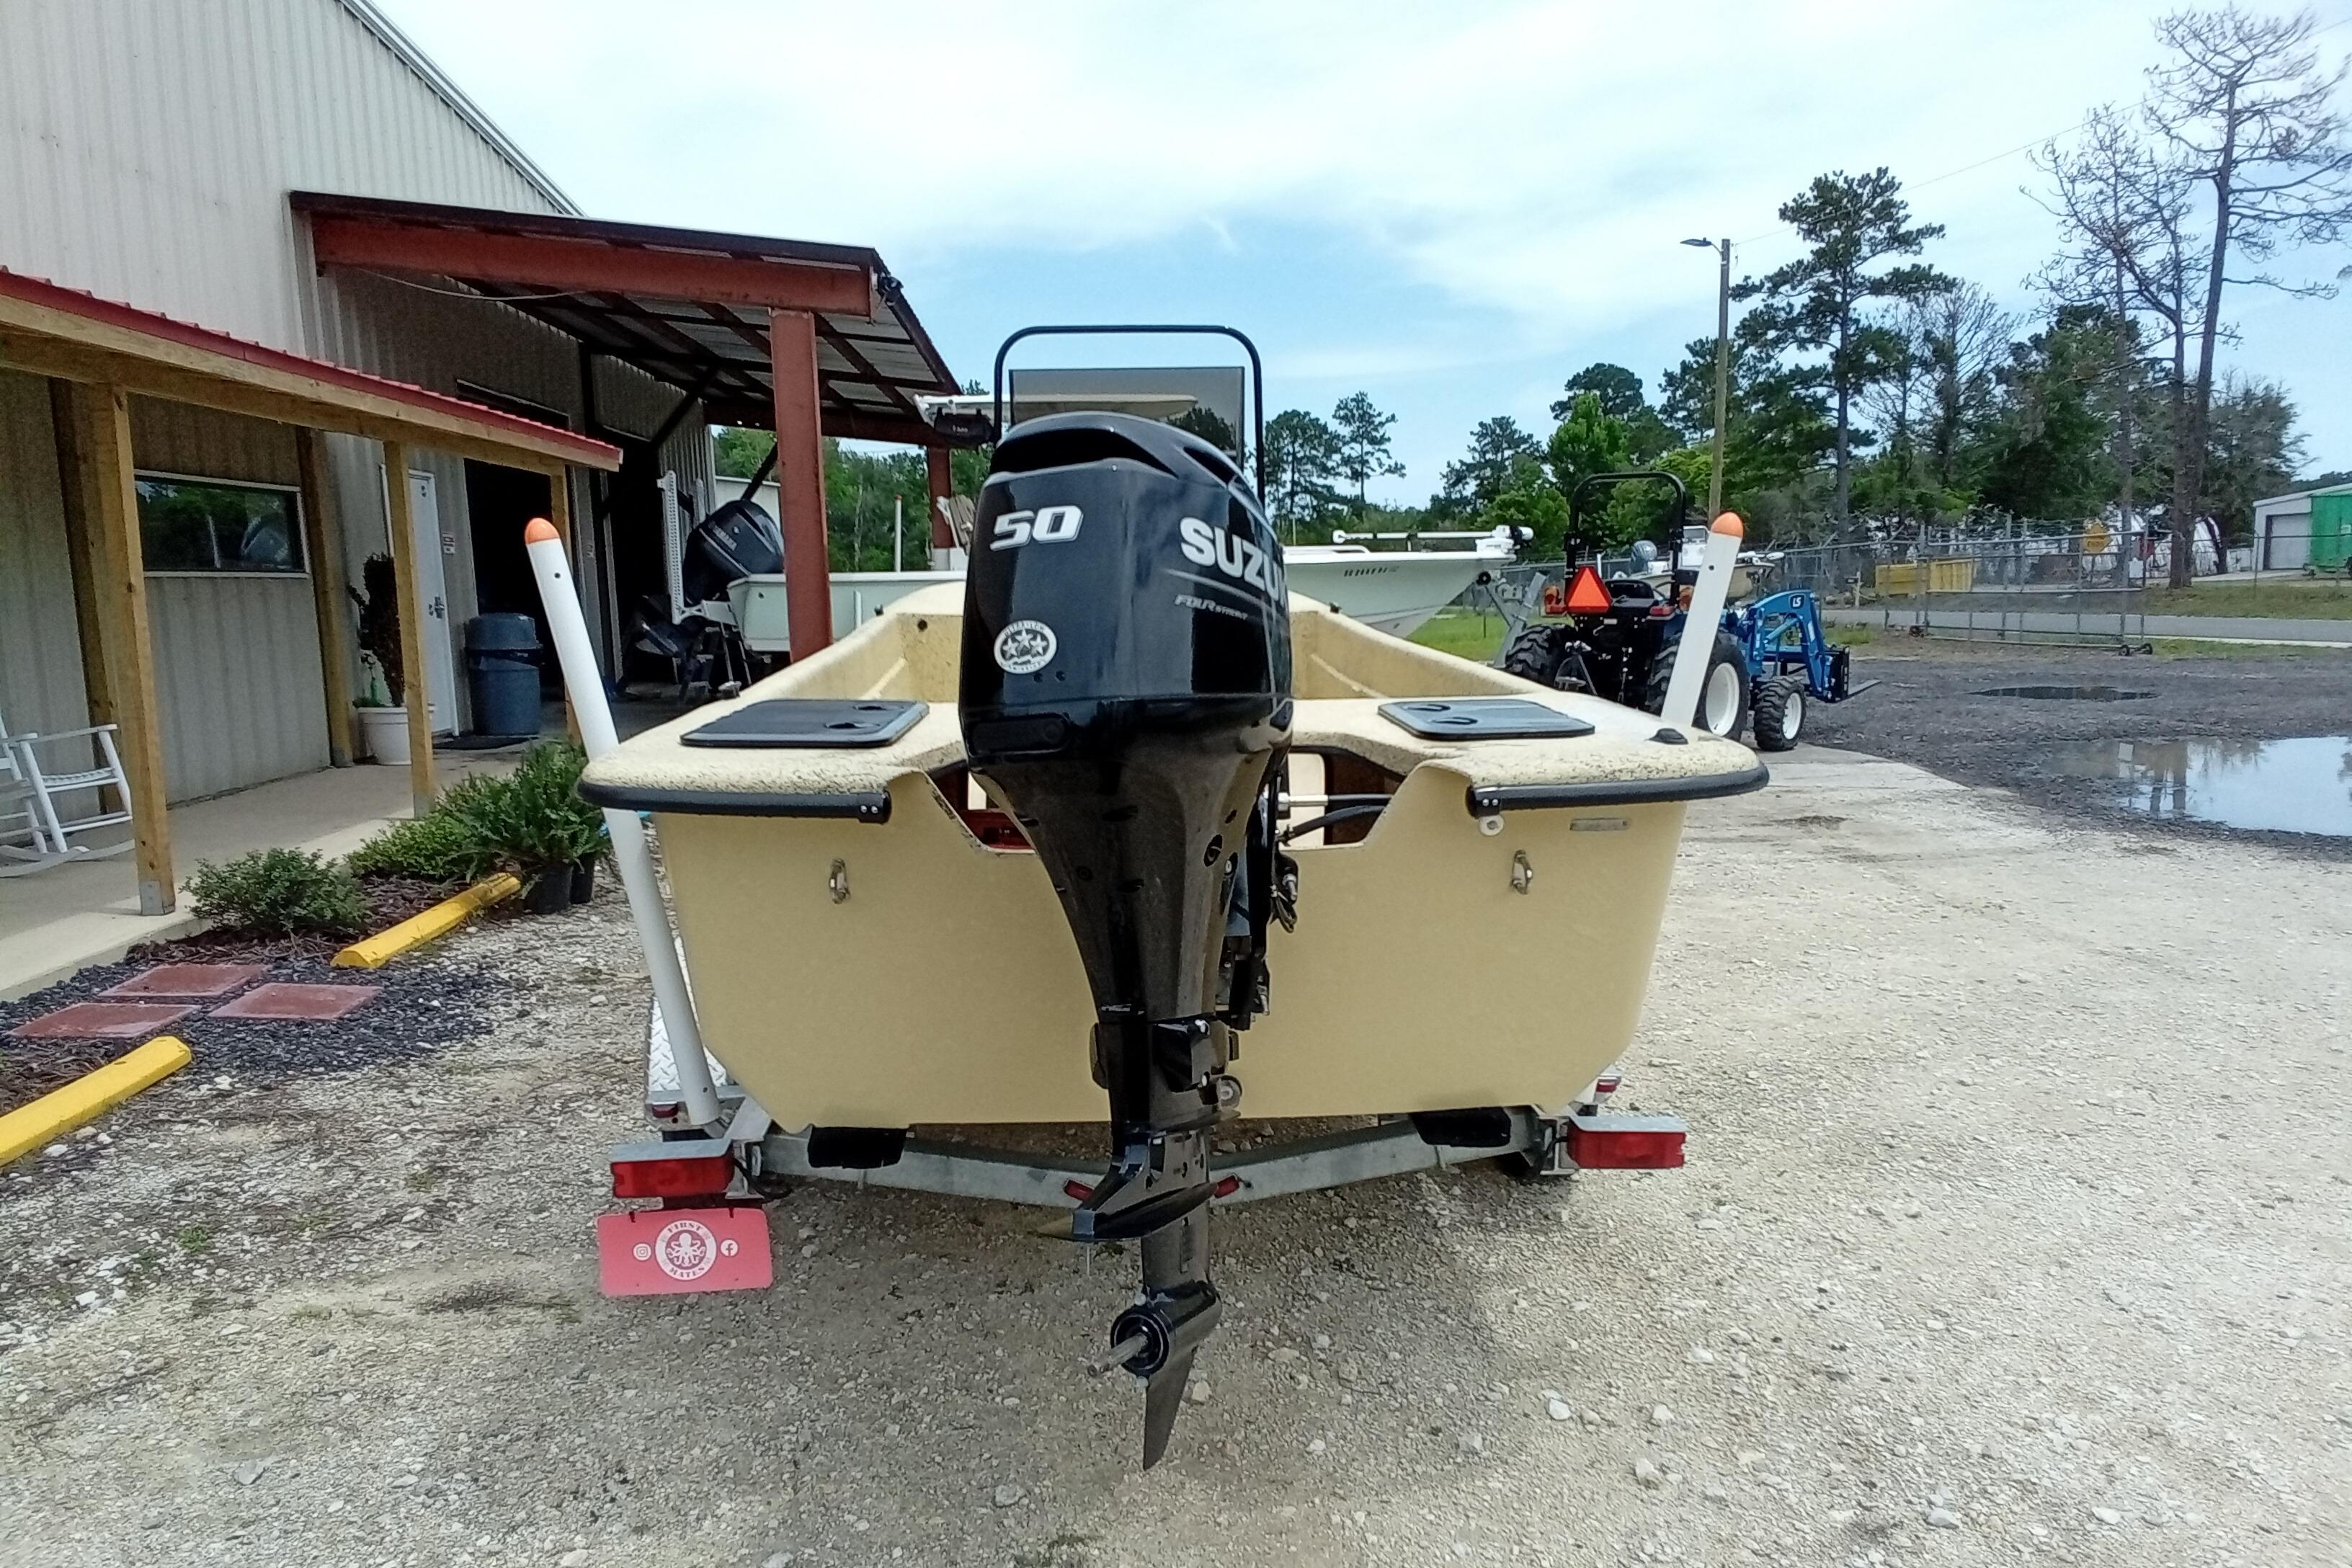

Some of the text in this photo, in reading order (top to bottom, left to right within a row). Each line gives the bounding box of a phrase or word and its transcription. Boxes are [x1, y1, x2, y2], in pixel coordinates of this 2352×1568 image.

[989, 505, 1084, 552] 50
[1792, 597, 1802, 607] LS
[667, 1221, 703, 1234] FIRST
[669, 1267, 705, 1278] MATES
